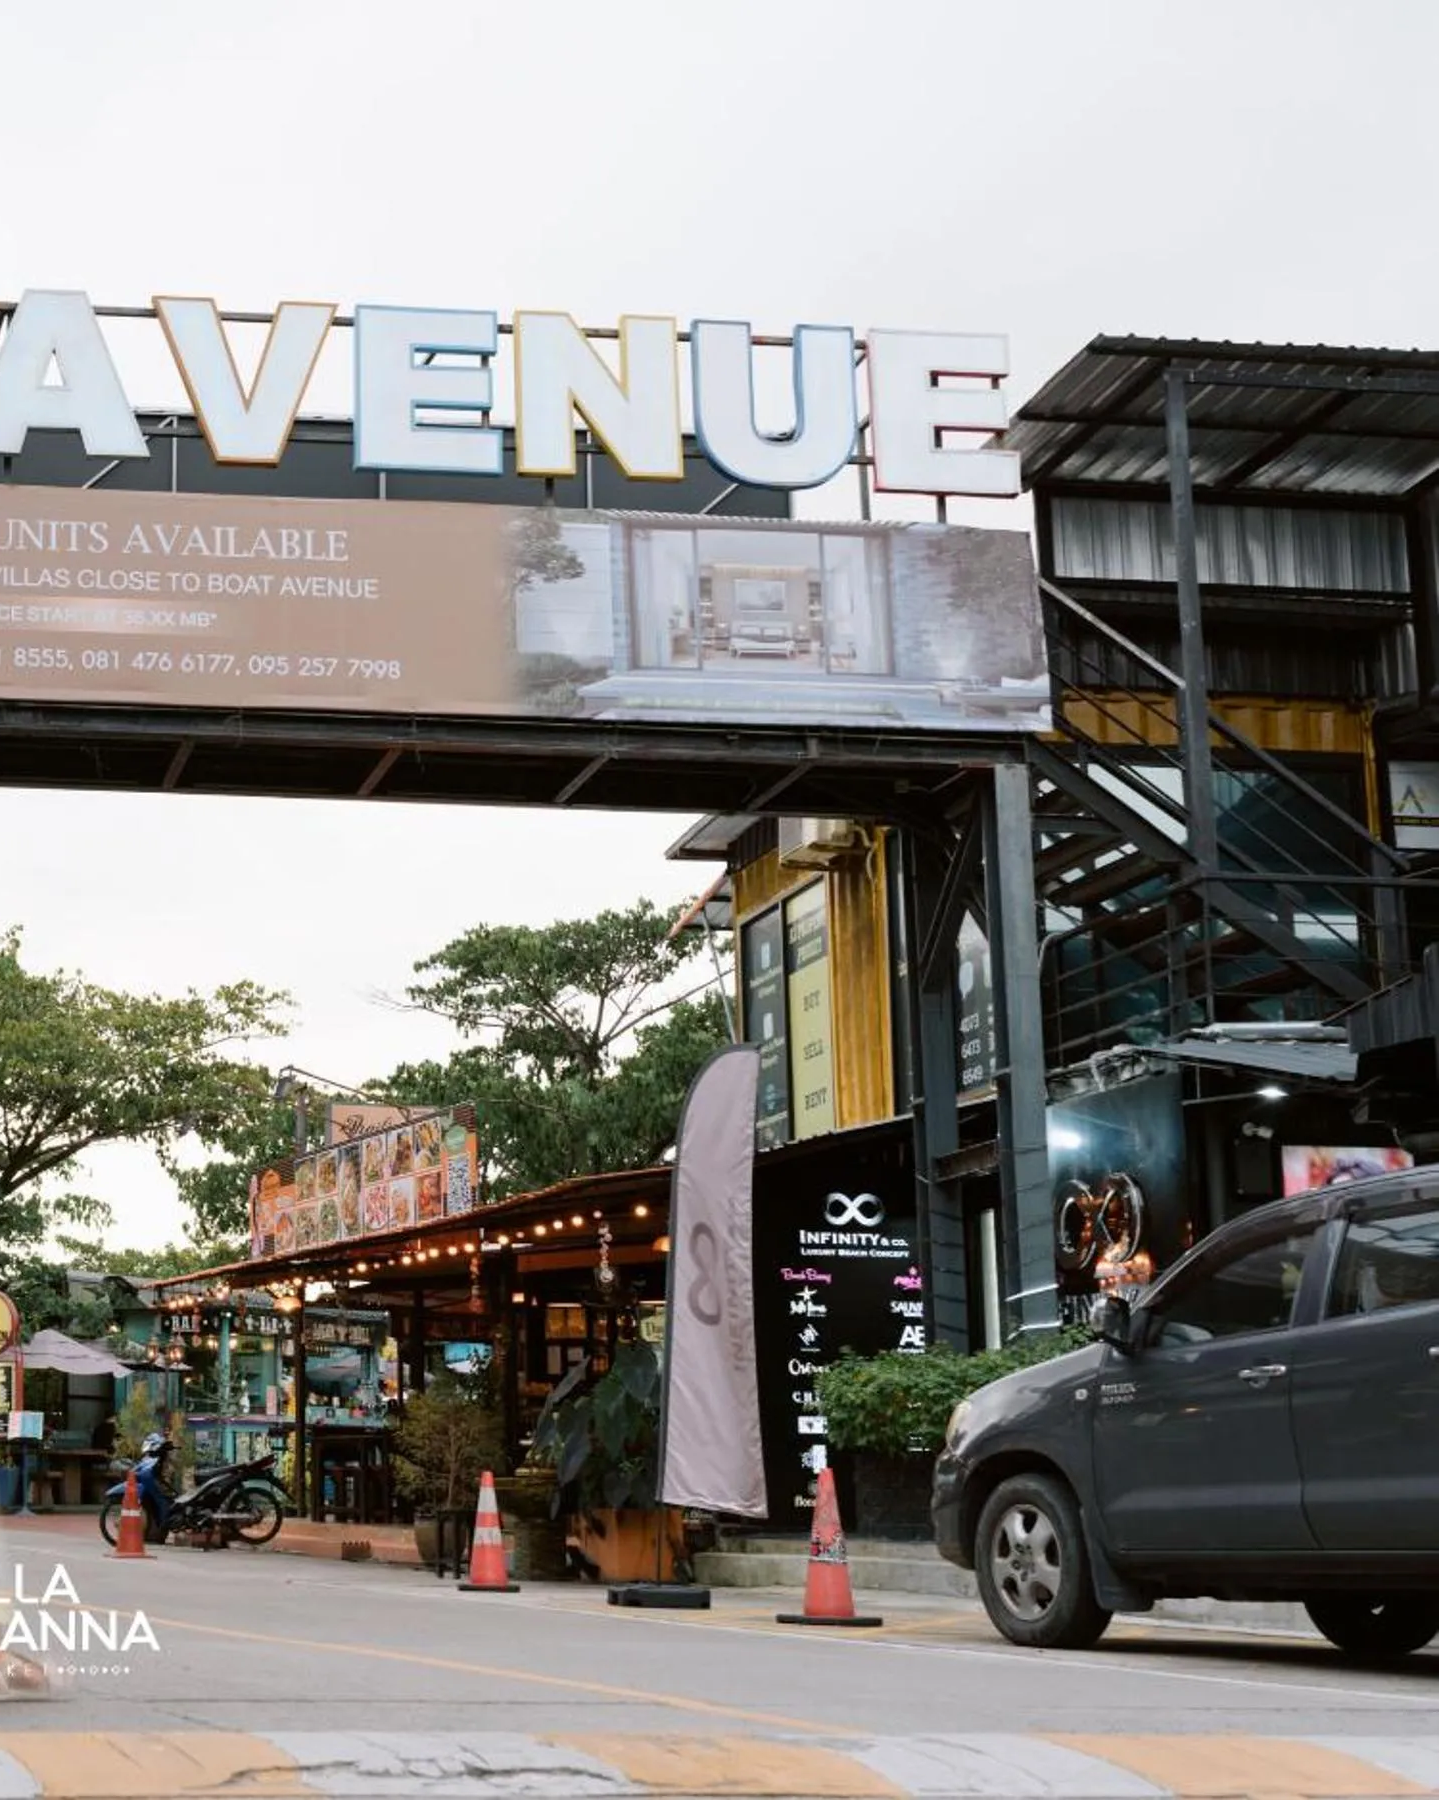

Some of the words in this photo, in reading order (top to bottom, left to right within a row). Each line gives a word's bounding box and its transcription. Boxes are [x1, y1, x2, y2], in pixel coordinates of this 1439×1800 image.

[122, 523, 349, 562] AVAILABLE
[77, 569, 161, 592] CLOSE
[166, 571, 201, 593] TO
[207, 573, 274, 596] BOAT
[279, 576, 379, 599] AVENUE
[14, 648, 74, 671] 8555,
[81, 650, 120, 670] 081
[131, 651, 173, 672] 476
[181, 653, 241, 677] 6177,
[248, 655, 290, 676] 095
[298, 657, 339, 677] 257
[347, 659, 401, 680] 7998
[799, 1229, 880, 1247] INFINITY
